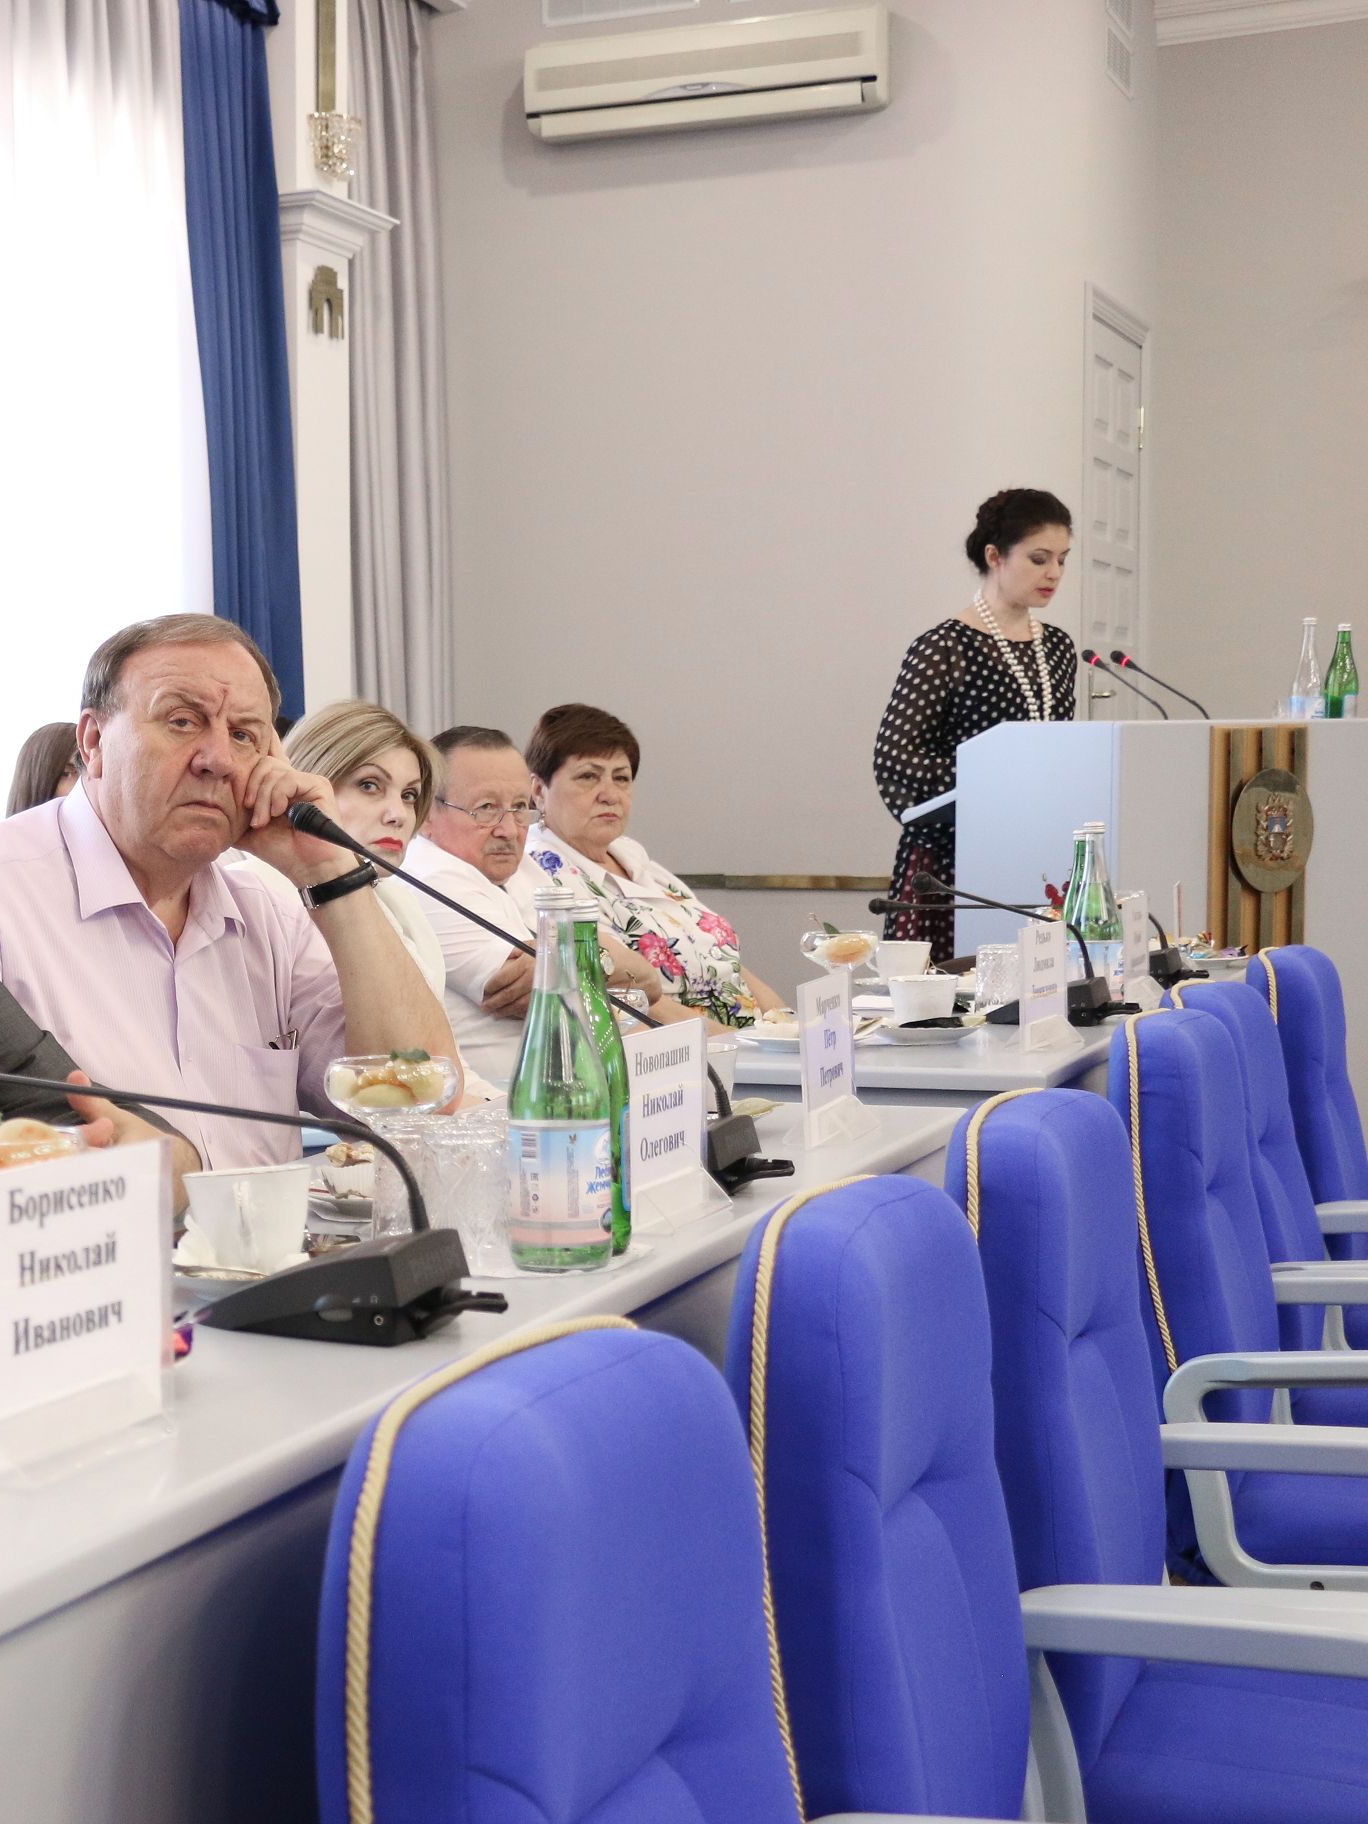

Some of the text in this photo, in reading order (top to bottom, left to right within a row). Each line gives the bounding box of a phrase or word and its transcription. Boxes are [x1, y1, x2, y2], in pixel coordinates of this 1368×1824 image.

[634, 1045, 690, 1077] Новопашин
[819, 1061, 844, 1088] Петрович
[642, 1083, 684, 1118] Николай
[640, 1130, 685, 1162] Олегович
[8, 1176, 126, 1228] Борисенко
[19, 1232, 117, 1287] Николай
[13, 1301, 122, 1355] Иванович
